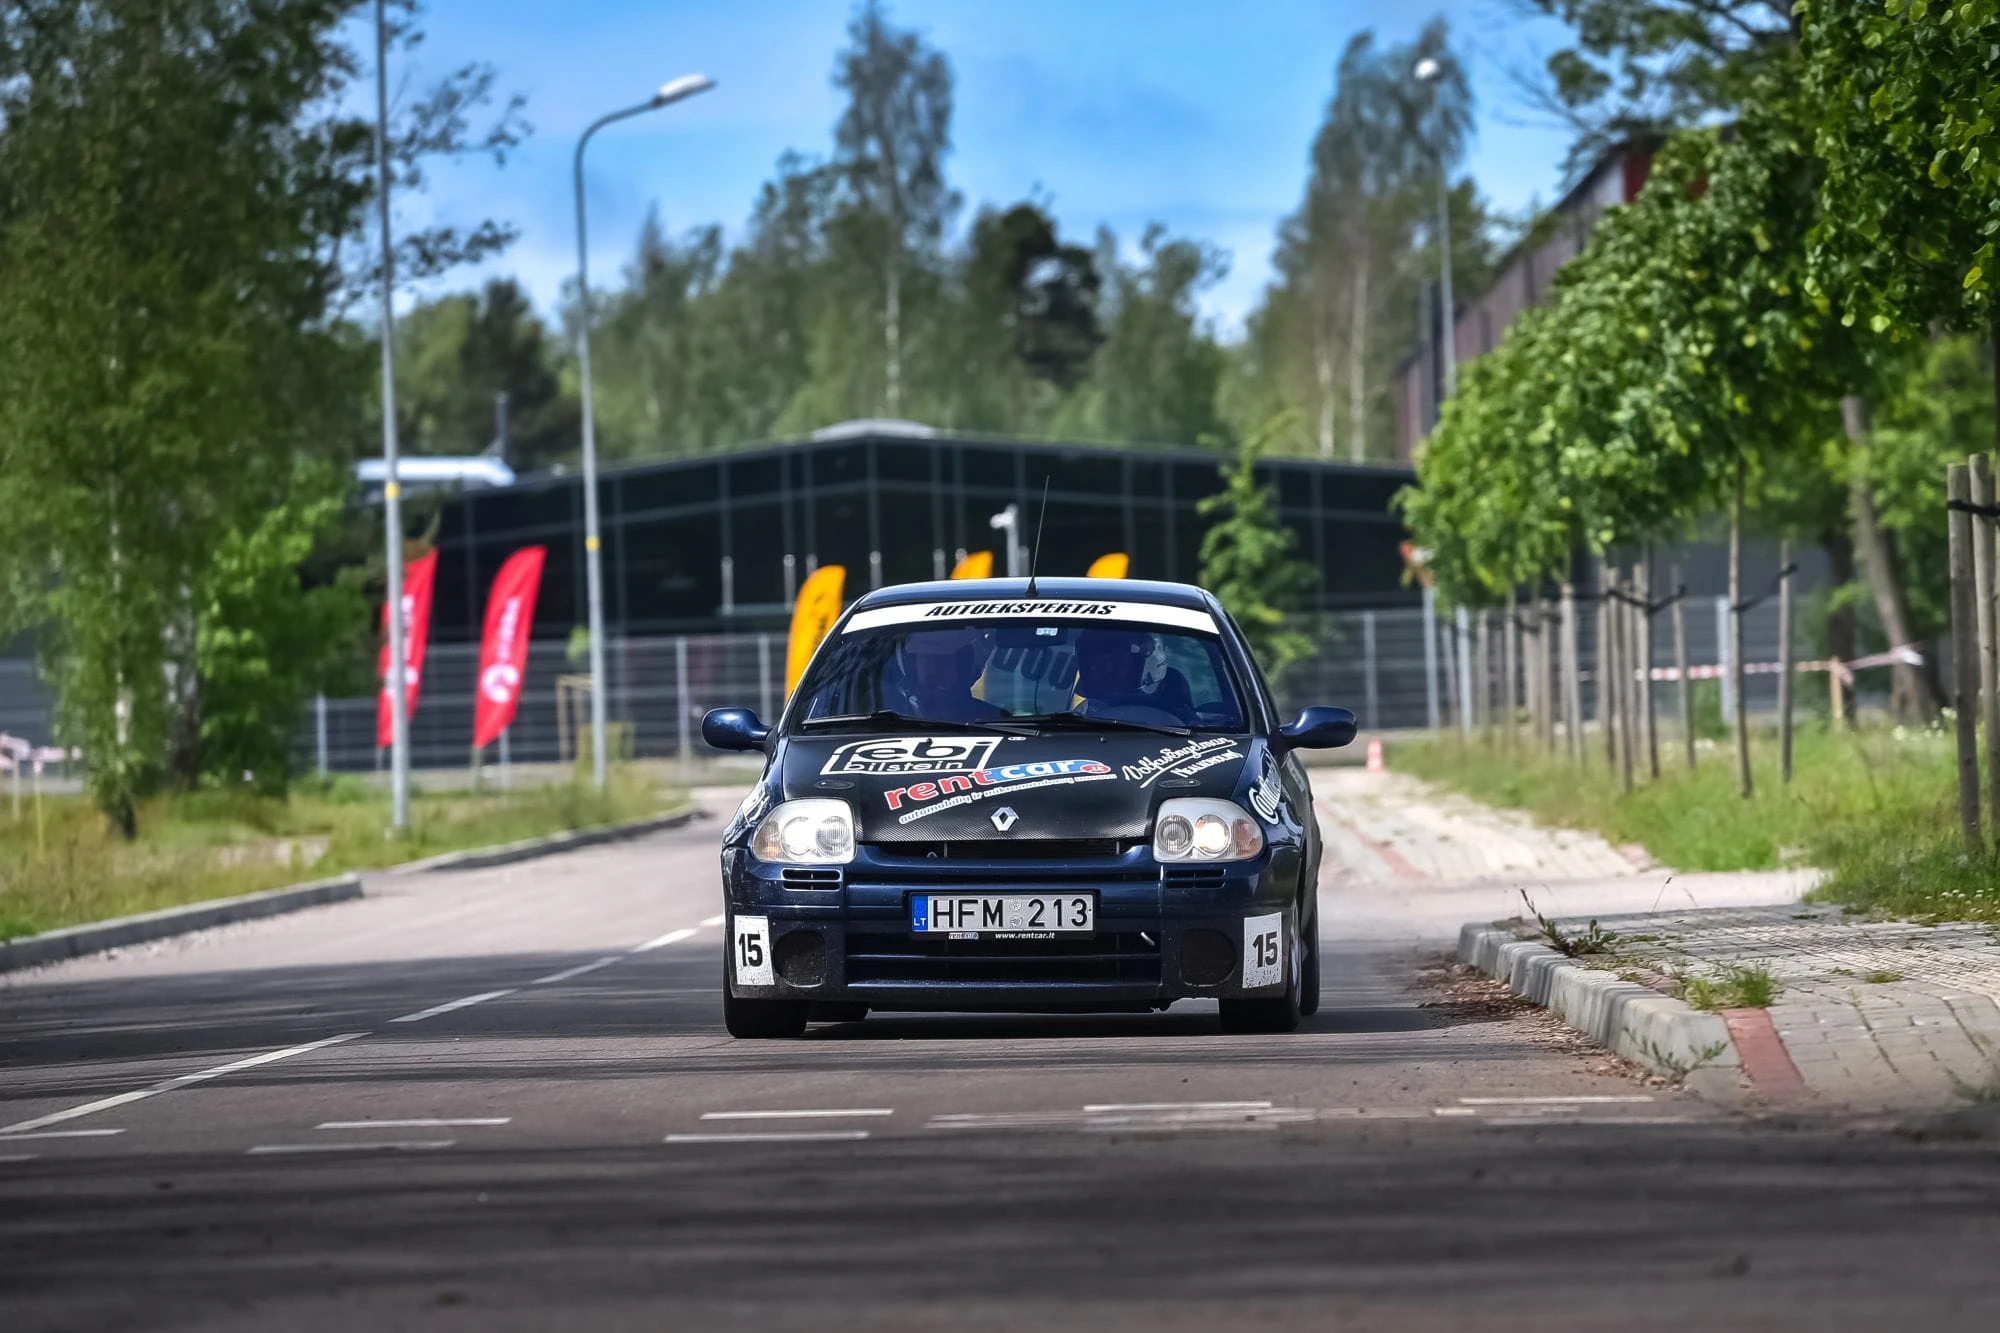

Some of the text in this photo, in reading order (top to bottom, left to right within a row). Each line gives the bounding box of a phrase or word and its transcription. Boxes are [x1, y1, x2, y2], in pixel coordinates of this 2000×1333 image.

[925, 602, 1117, 617] AUTOEKSPERTAS
[827, 738, 995, 772] febi
[843, 759, 963, 772] bilstein
[913, 917, 926, 926] LT
[932, 898, 1088, 928] HFM 213
[995, 931, 1055, 940] www.rentcar.lt
[738, 933, 763, 967] 15
[1252, 931, 1278, 968] 15
